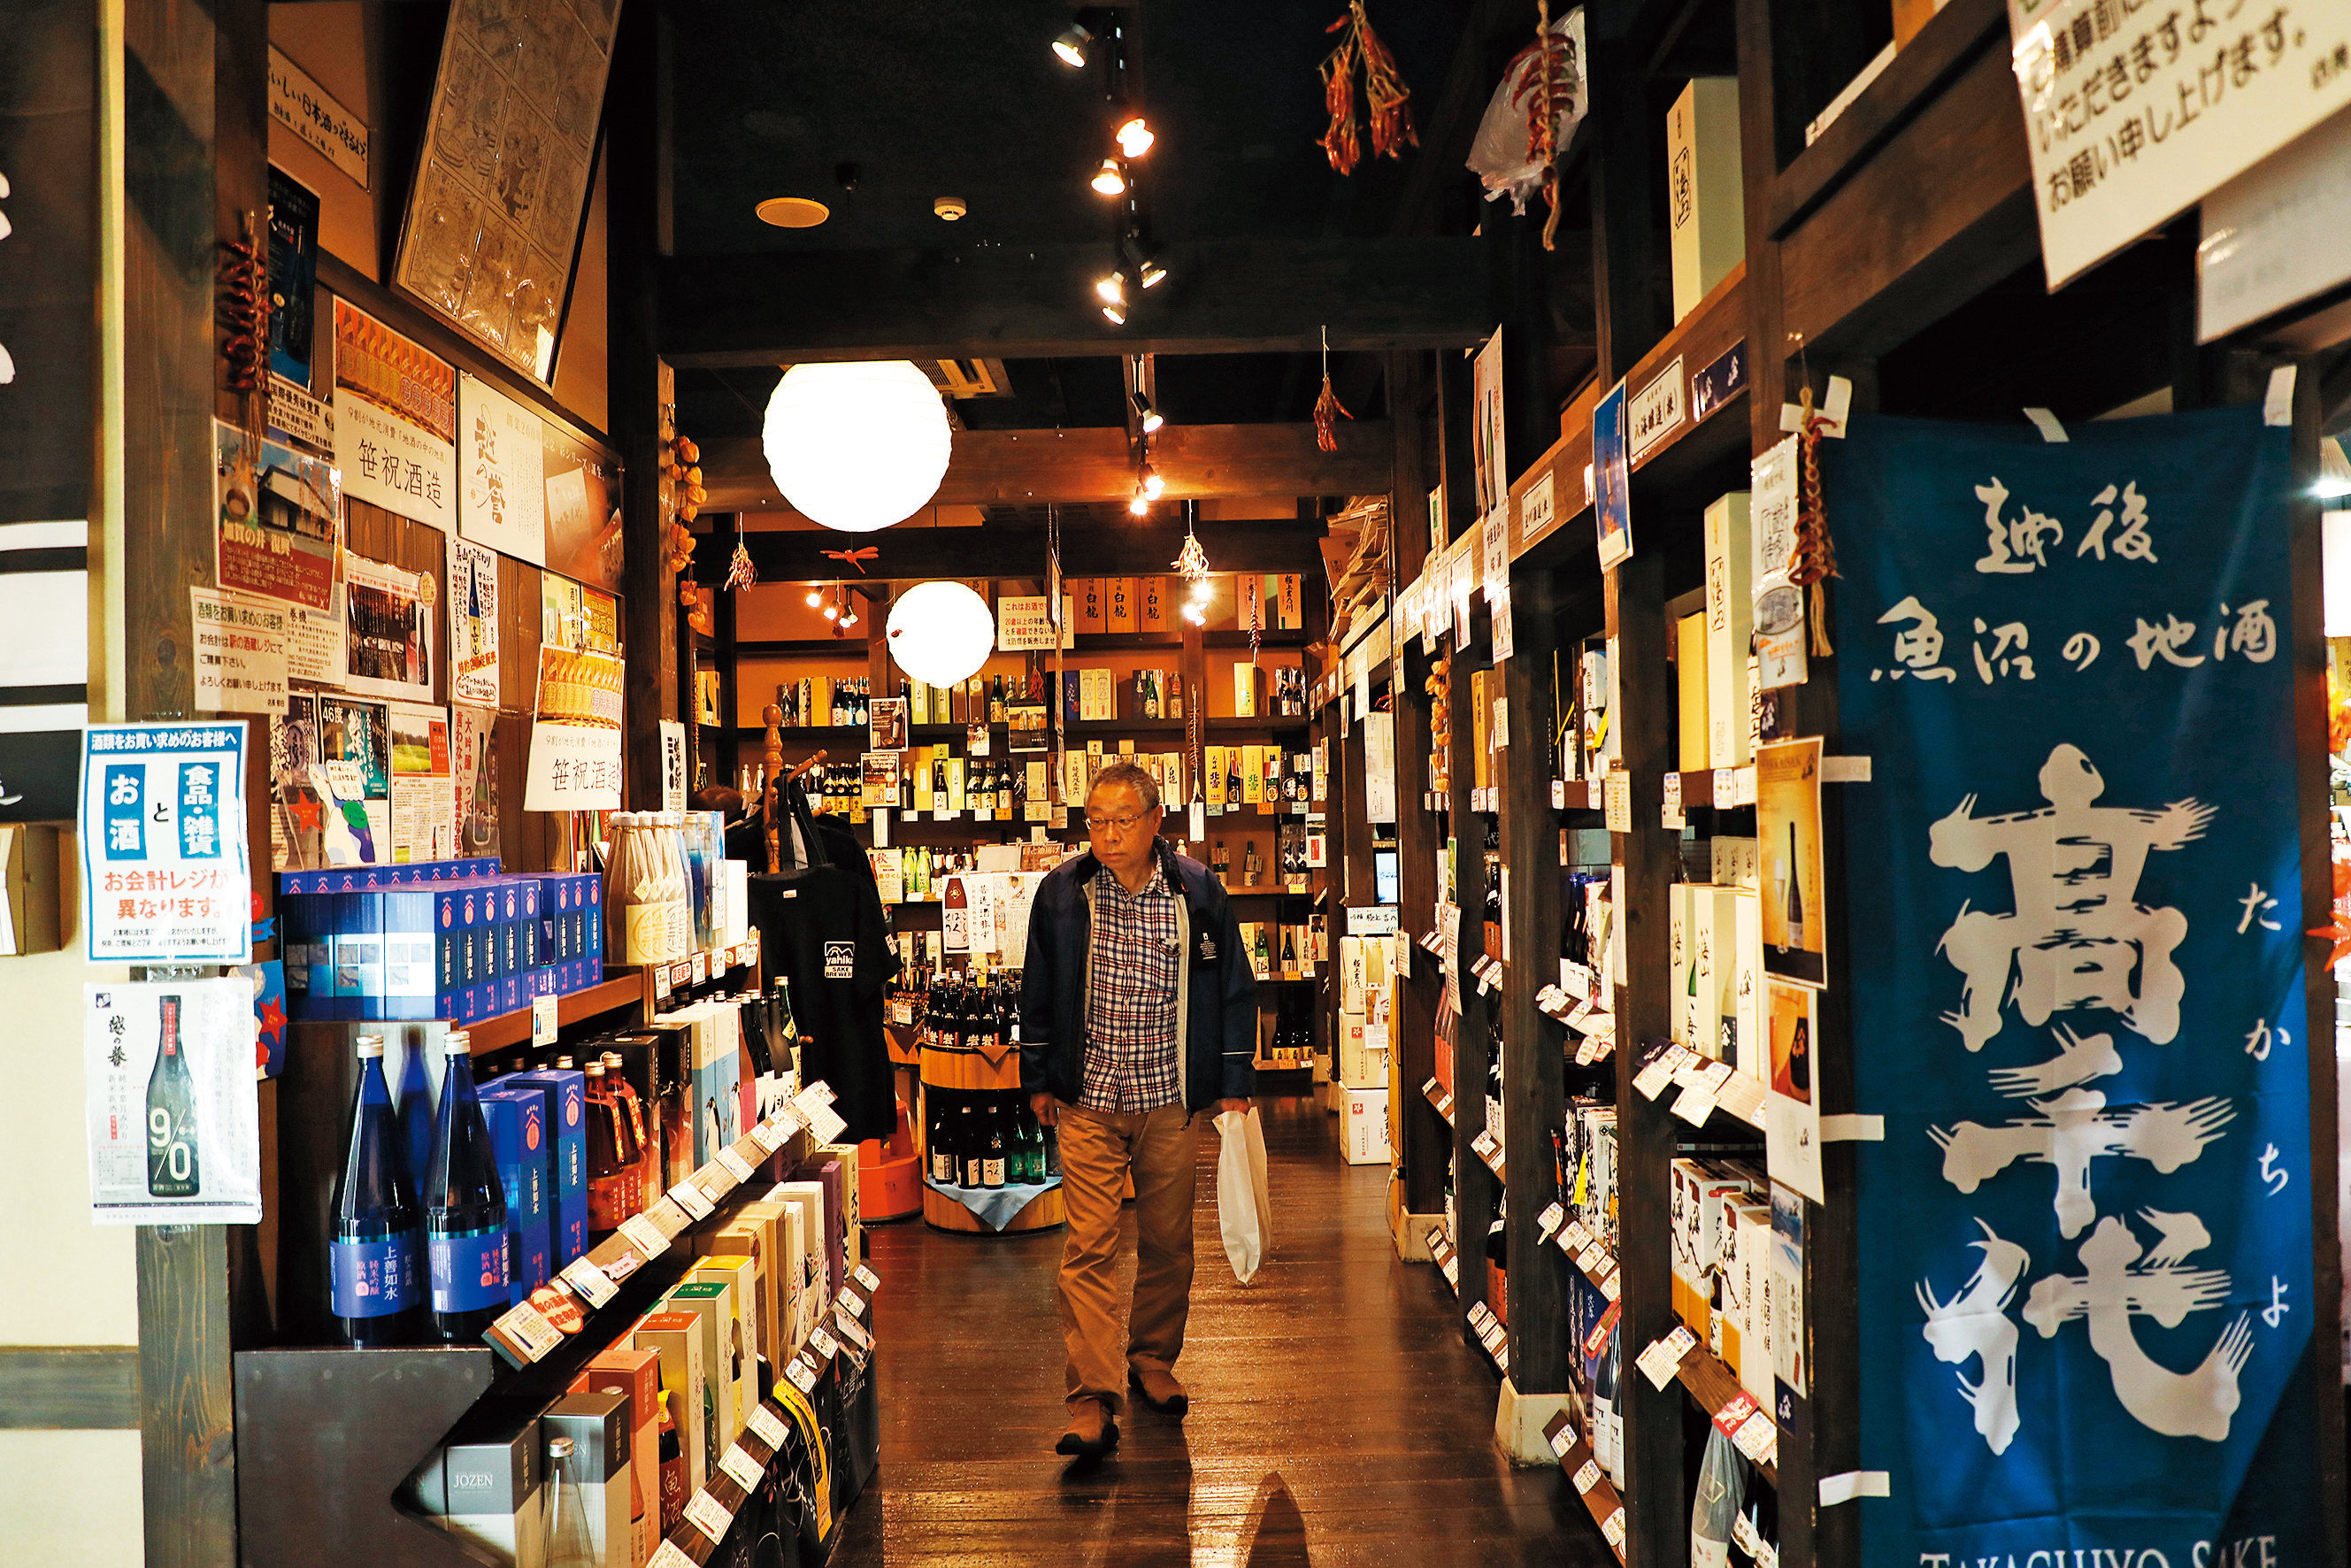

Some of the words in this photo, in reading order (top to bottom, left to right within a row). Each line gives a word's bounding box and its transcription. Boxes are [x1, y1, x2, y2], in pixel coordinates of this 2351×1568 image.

[2046, 7, 2307, 212] お願い申し上げます。
[358, 437, 442, 509] 笹祝酒造
[1974, 476, 2158, 574] 越後
[197, 602, 283, 631] 酒類をお買い求めのお客様
[199, 633, 283, 654] お会計は駅の酒蔵レジにて
[1870, 596, 2278, 685] 魚沼の地酒
[199, 655, 246, 669] ご精算下さい。
[200, 675, 285, 693] よろしくお願い申し上げます。
[322, 705, 344, 724] 46度
[91, 730, 237, 751] 酒類をお買い求めのお客様へ
[109, 772, 141, 851] お酒
[152, 802, 169, 823] と
[183, 765, 215, 856] 食品・雑貨
[876, 852, 887, 864] 秋
[104, 870, 228, 893] お会計レジが
[117, 898, 221, 920] 異なります。
[108, 1015, 127, 1067] 越の誉
[2237, 882, 2291, 1327] たかちよ
[356, 1260, 366, 1280] 原酒
[369, 1260, 380, 1296] 純米吟醸
[383, 1246, 398, 1301] 上善如水
[453, 1475, 494, 1488] JOZEN
